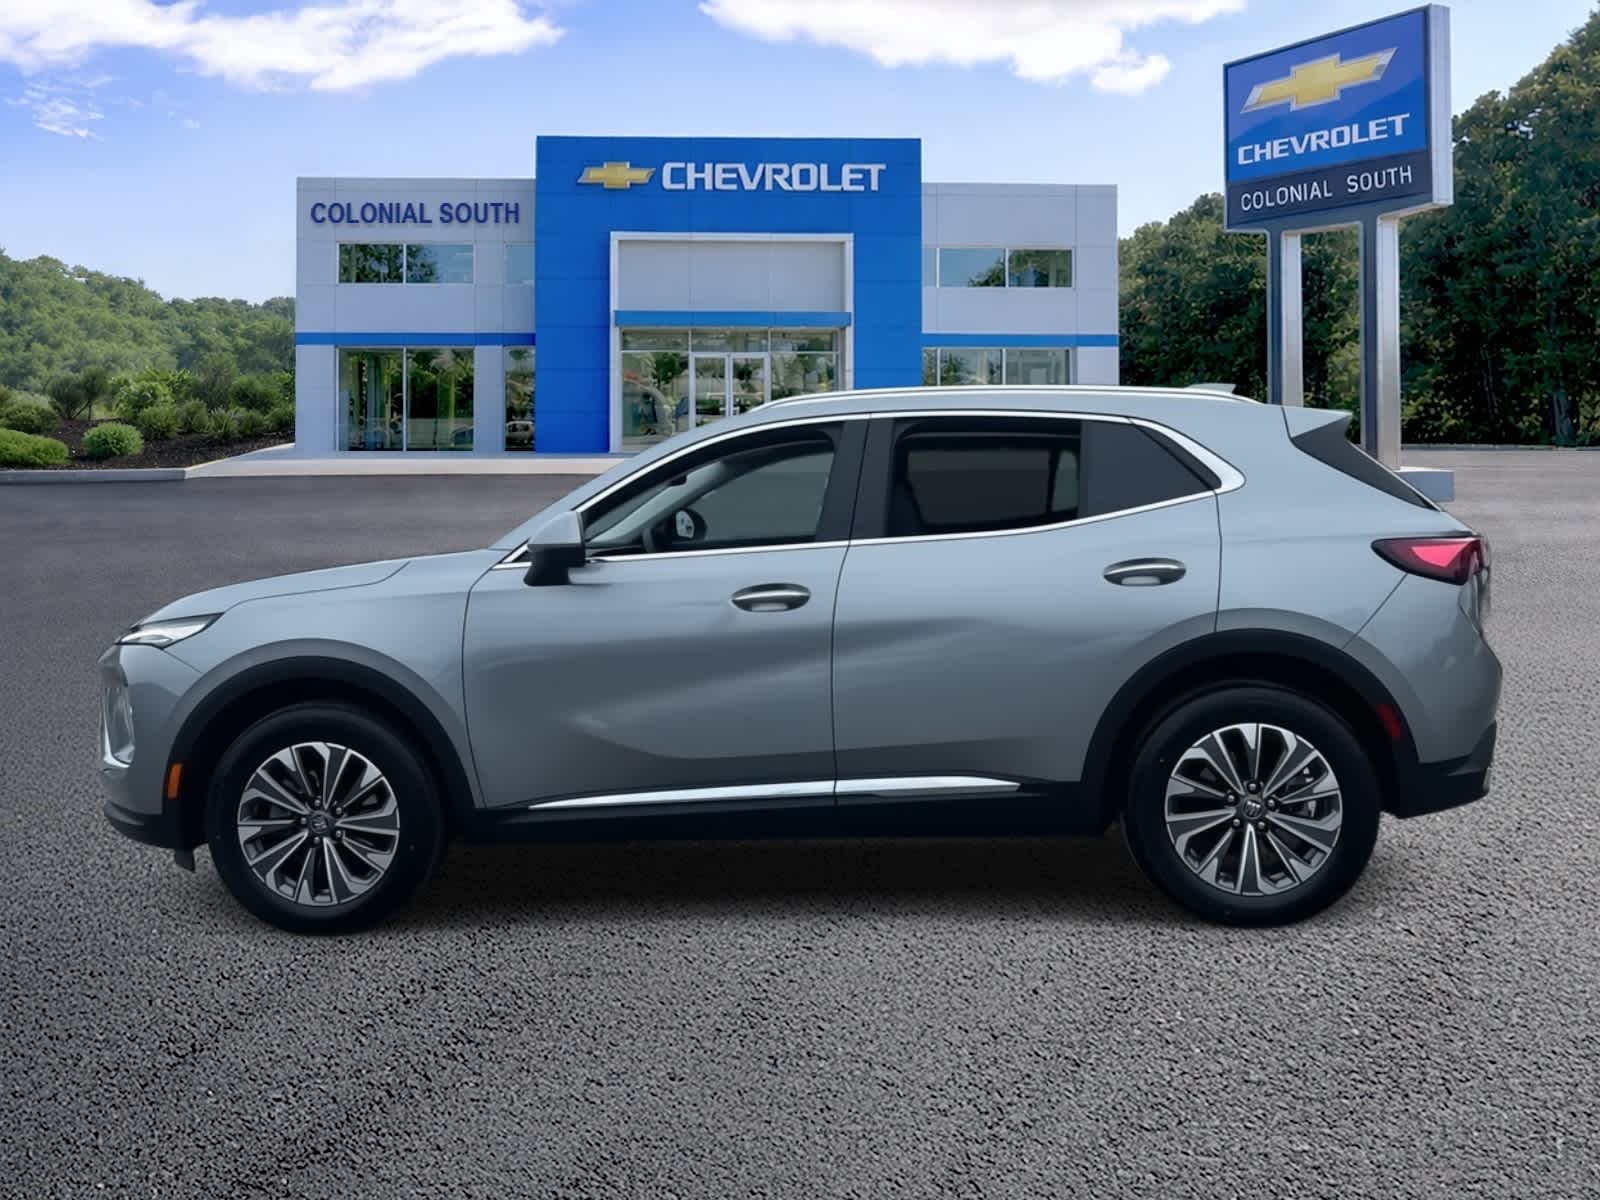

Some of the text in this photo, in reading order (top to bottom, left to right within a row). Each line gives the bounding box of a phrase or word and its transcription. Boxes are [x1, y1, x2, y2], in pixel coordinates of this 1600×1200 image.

[1238, 113, 1410, 165] CHEVROLET
[662, 162, 887, 192] CHEVROLET
[1241, 165, 1412, 211] COLONIAL SOUTH
[310, 203, 520, 225] COLONIAL SOUTH
